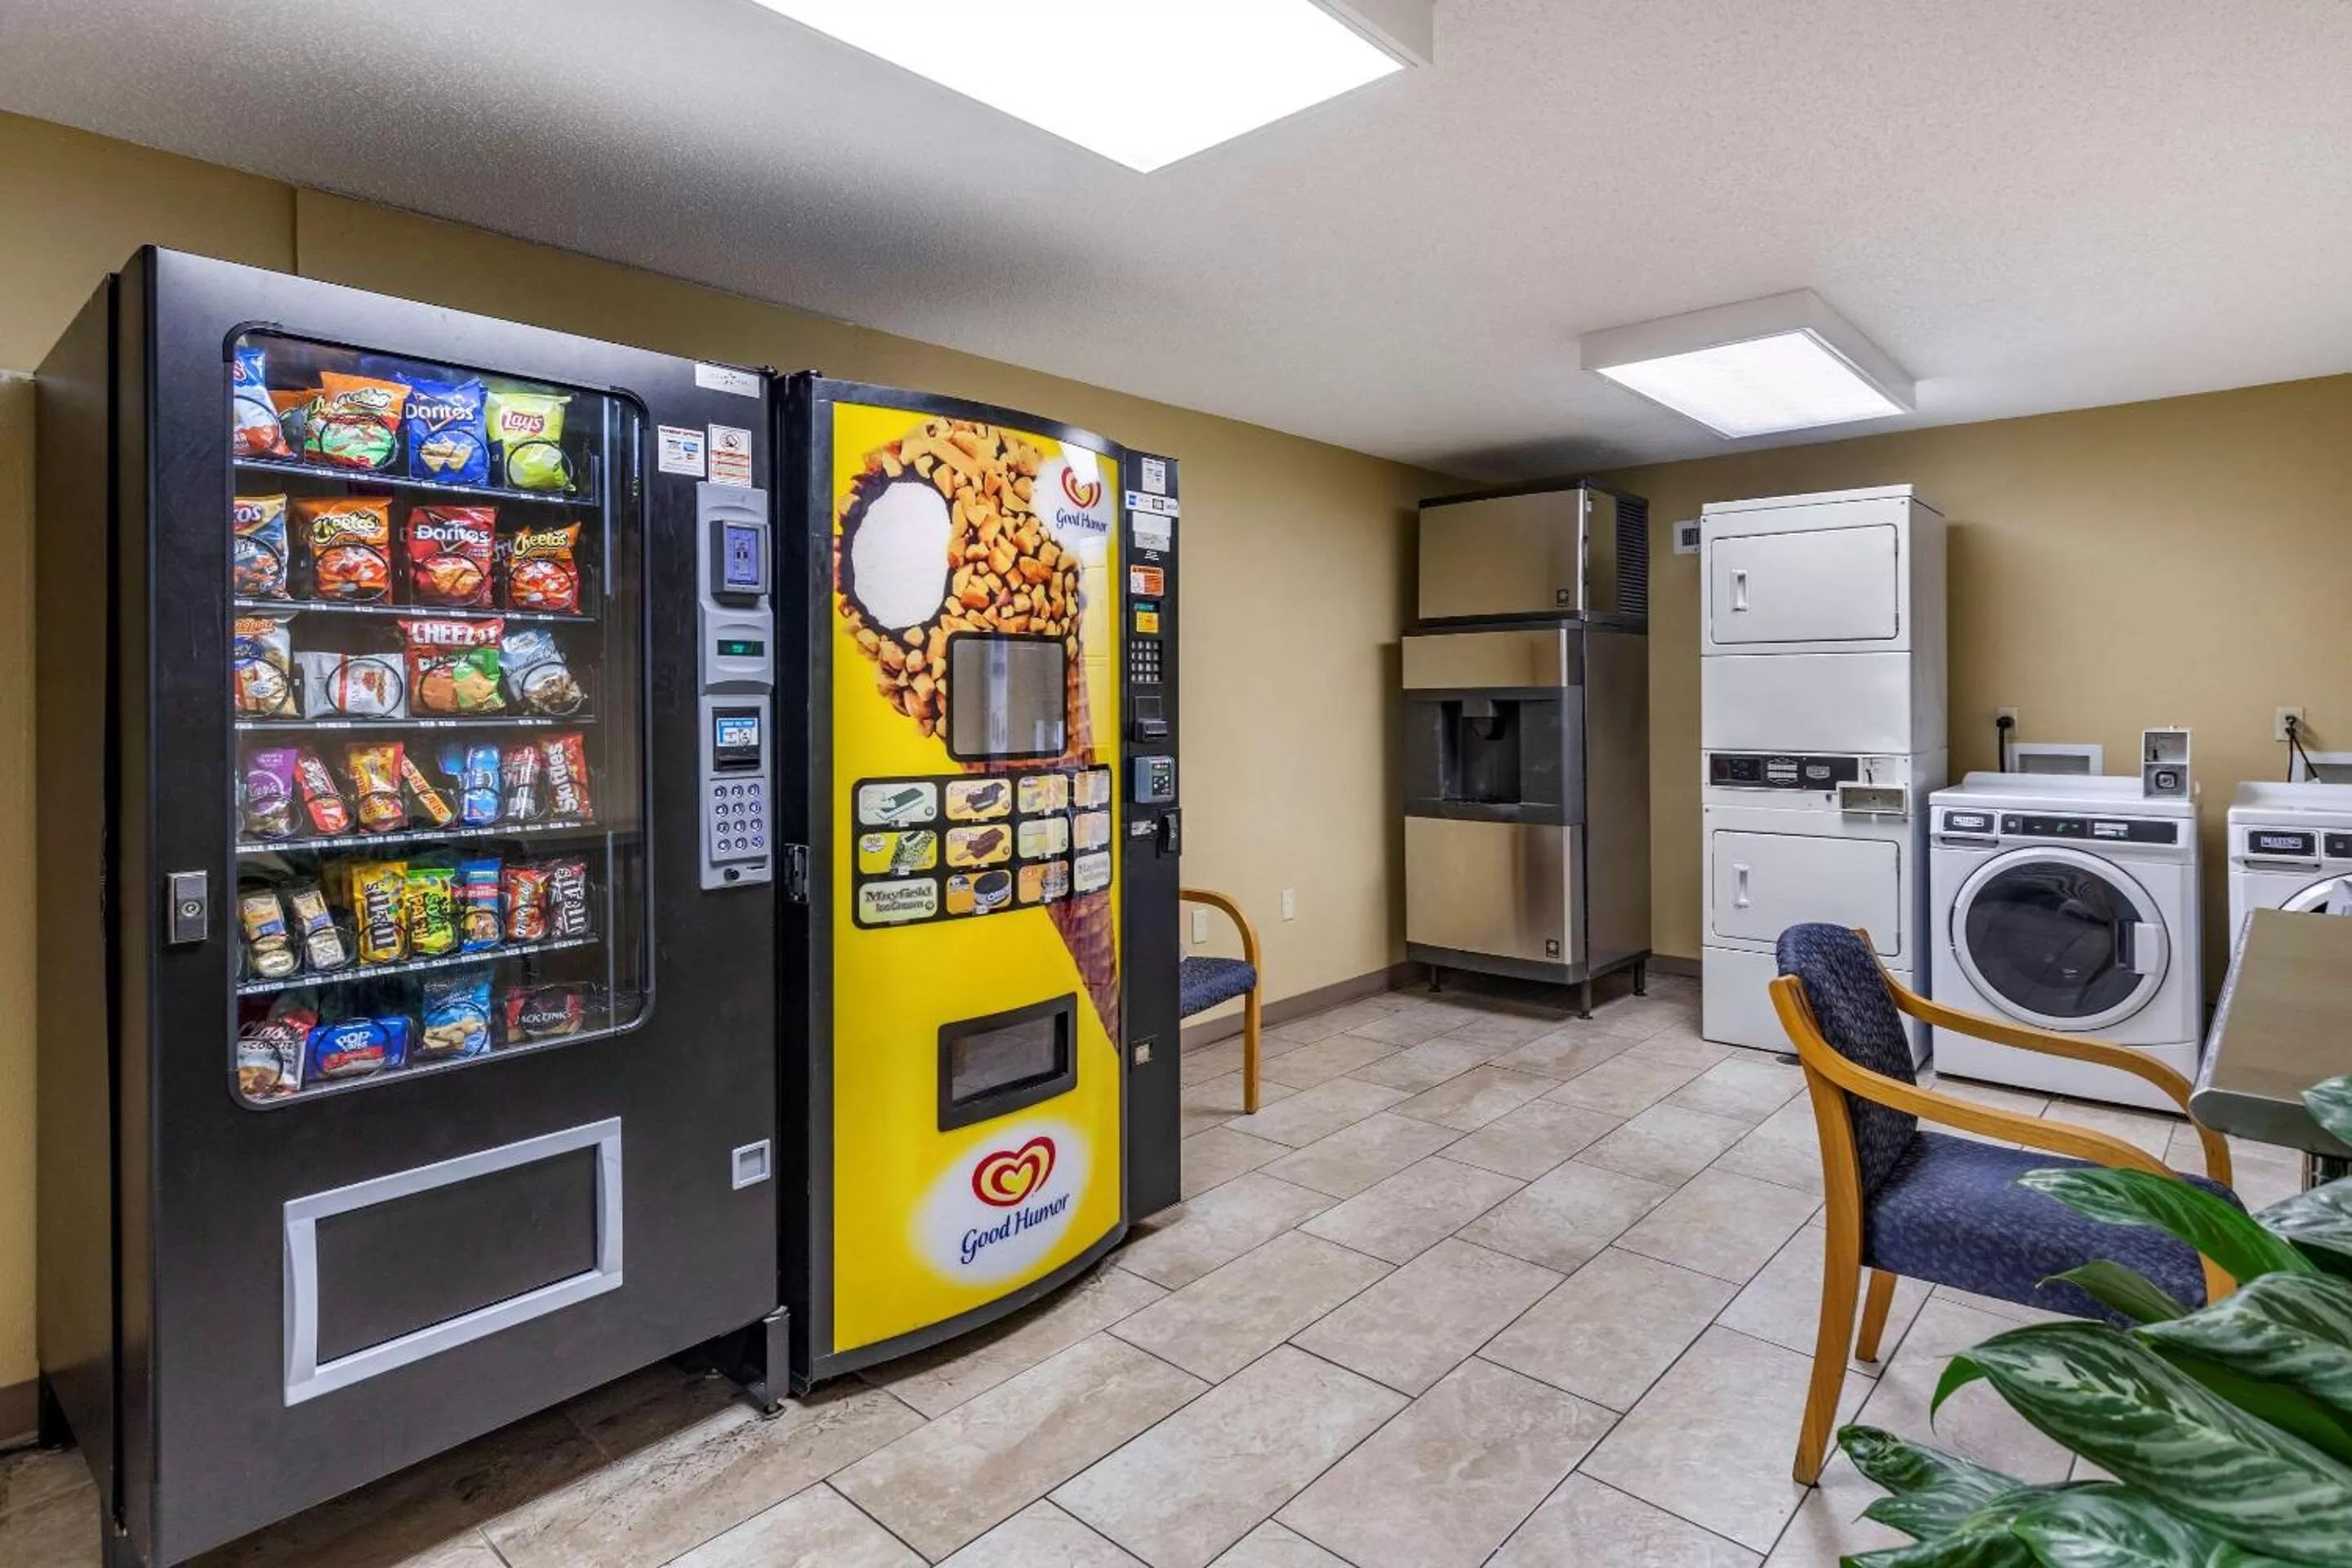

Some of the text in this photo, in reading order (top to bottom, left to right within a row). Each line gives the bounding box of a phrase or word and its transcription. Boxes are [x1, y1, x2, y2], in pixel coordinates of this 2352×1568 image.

[406, 399, 474, 421] Doritos
[313, 510, 378, 545] Cheetos
[1056, 507, 1107, 533] Good Humor
[416, 523, 490, 545] Doritos
[514, 532, 568, 557] Cheetos
[960, 1193, 1070, 1265] Good Humor
